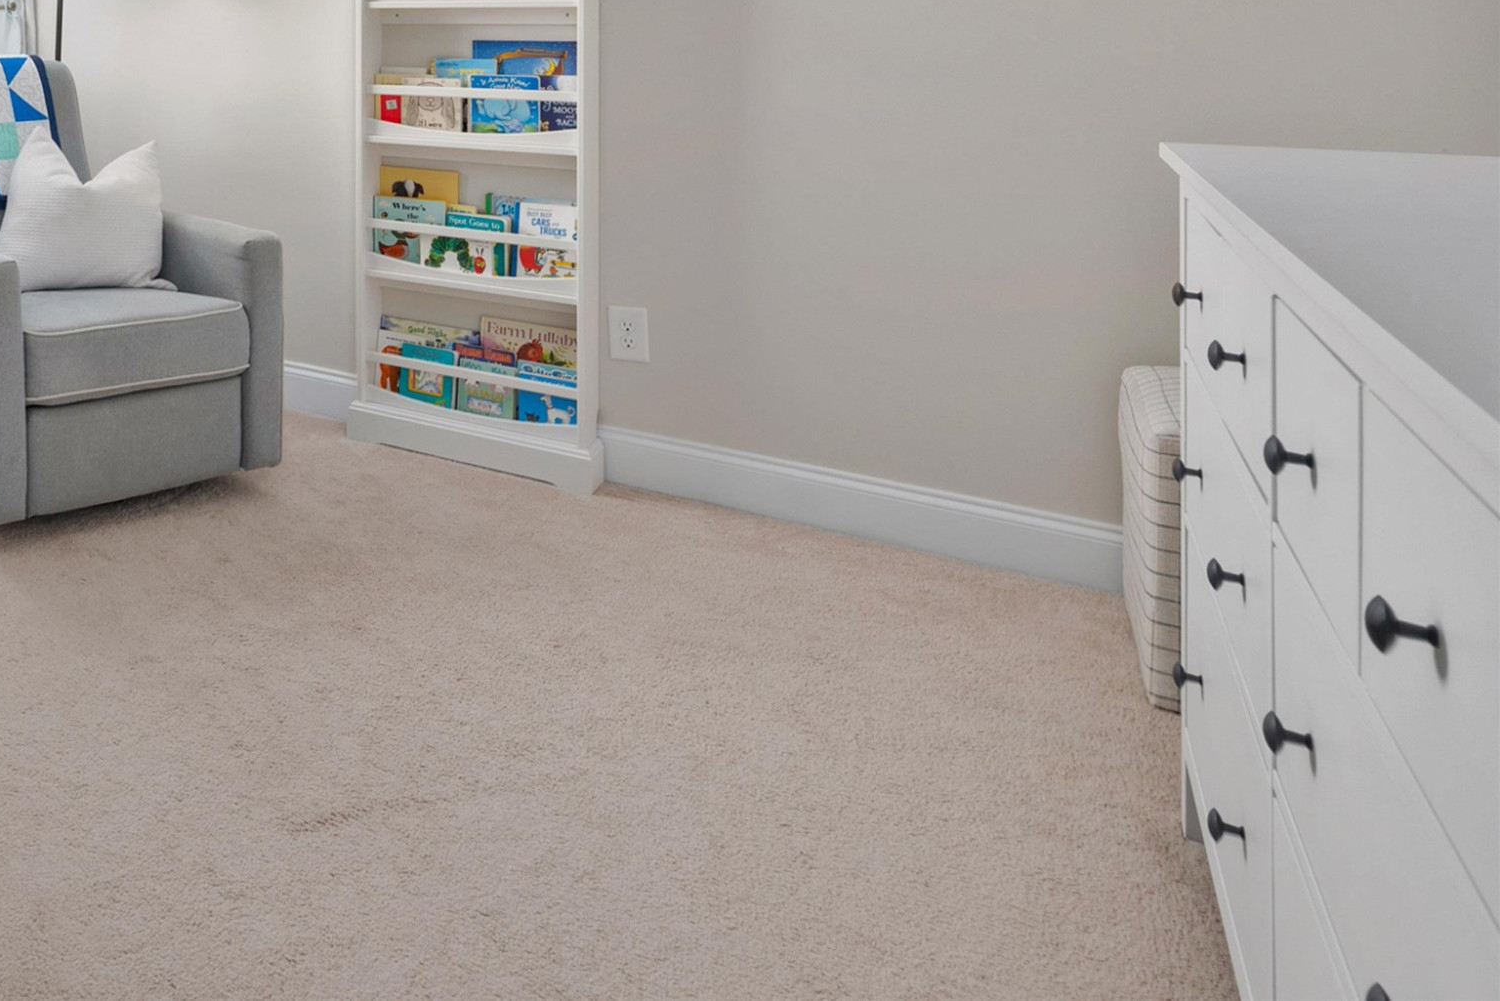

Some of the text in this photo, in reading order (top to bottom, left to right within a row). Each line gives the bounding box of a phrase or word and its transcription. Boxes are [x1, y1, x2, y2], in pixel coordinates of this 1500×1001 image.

[392, 201, 426, 212] Where's
[448, 215, 500, 230] Spot Goes to
[531, 218, 550, 227] CARS
[539, 226, 567, 237] TRUCKS
[486, 320, 526, 339] Farm
